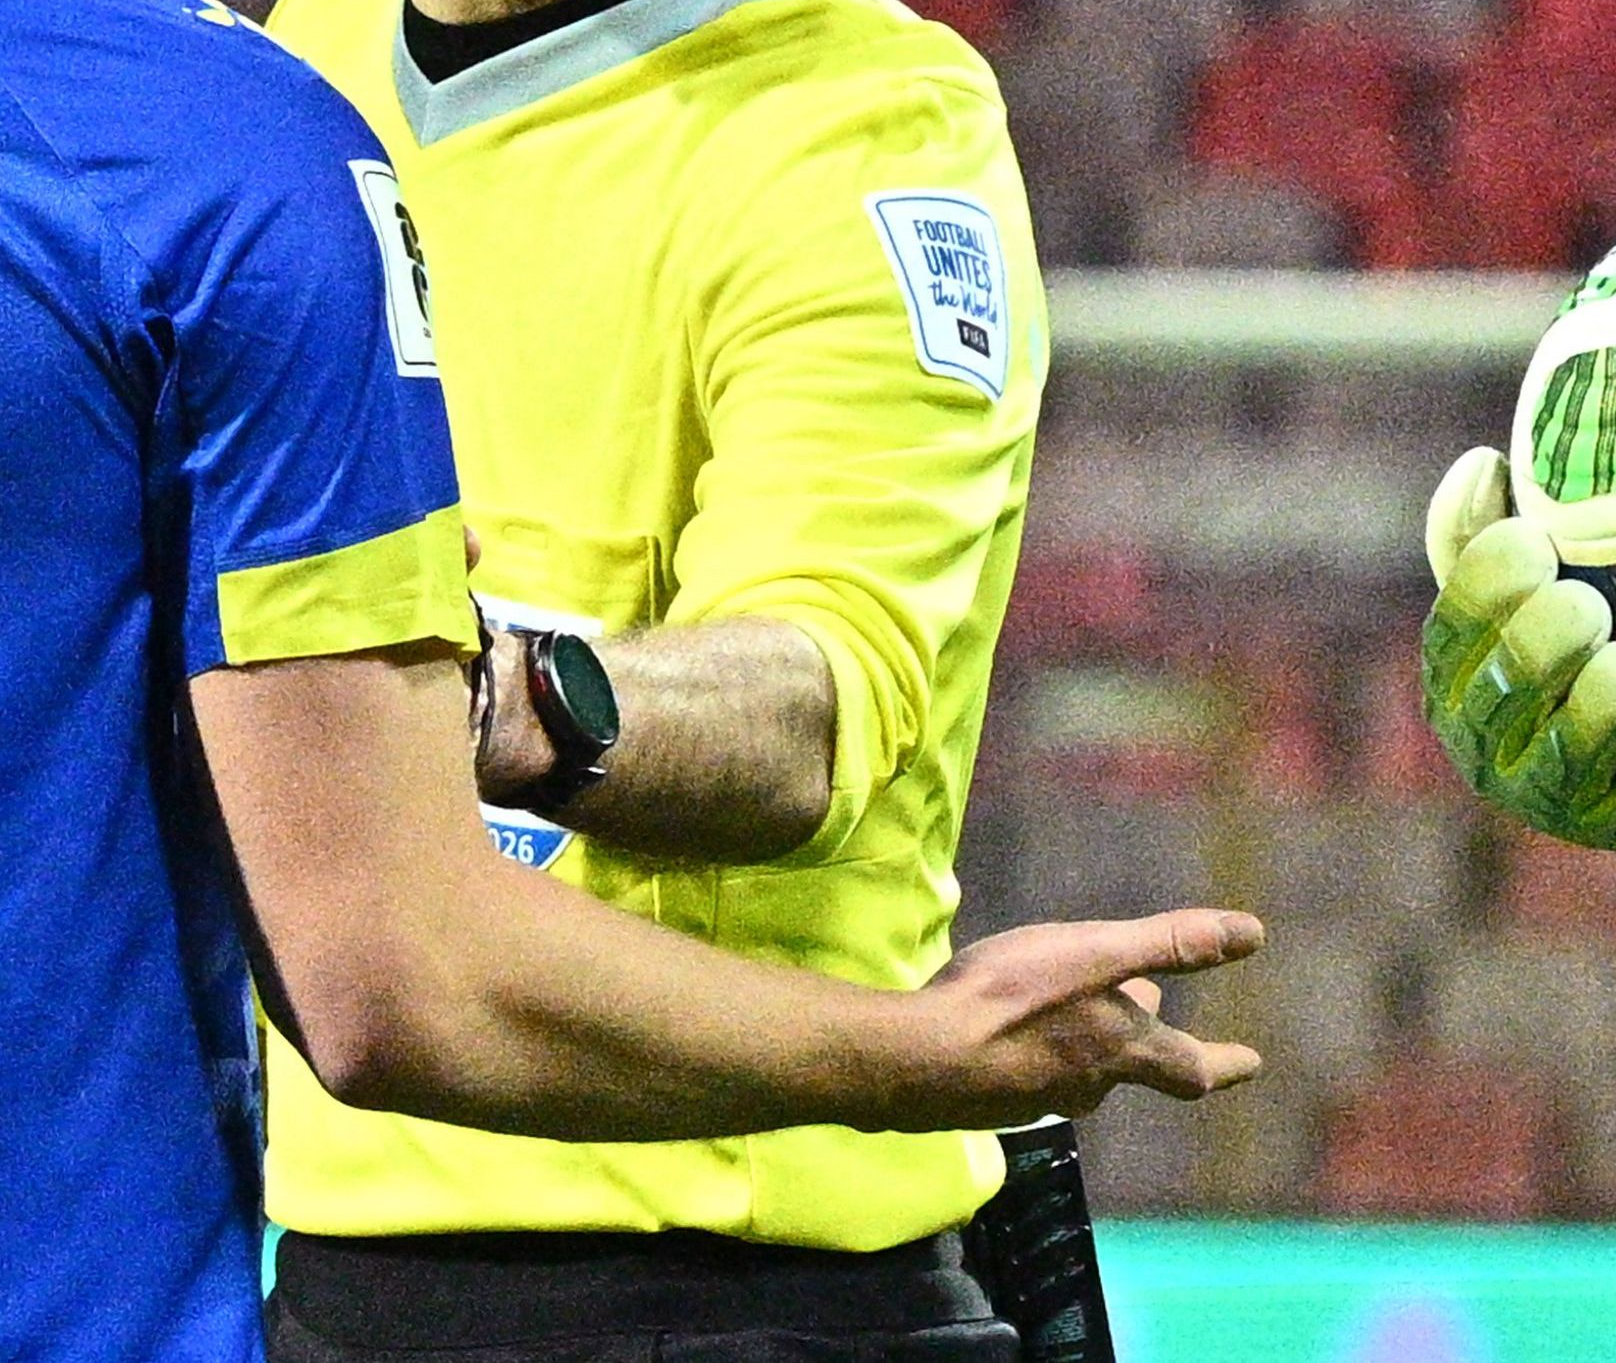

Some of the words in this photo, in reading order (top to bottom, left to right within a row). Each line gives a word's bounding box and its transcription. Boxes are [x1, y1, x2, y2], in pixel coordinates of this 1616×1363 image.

[913, 219, 988, 257] FOOTBALL
[923, 244, 993, 294] UNITES
[928, 279, 960, 308] the
[960, 285, 998, 326] World
